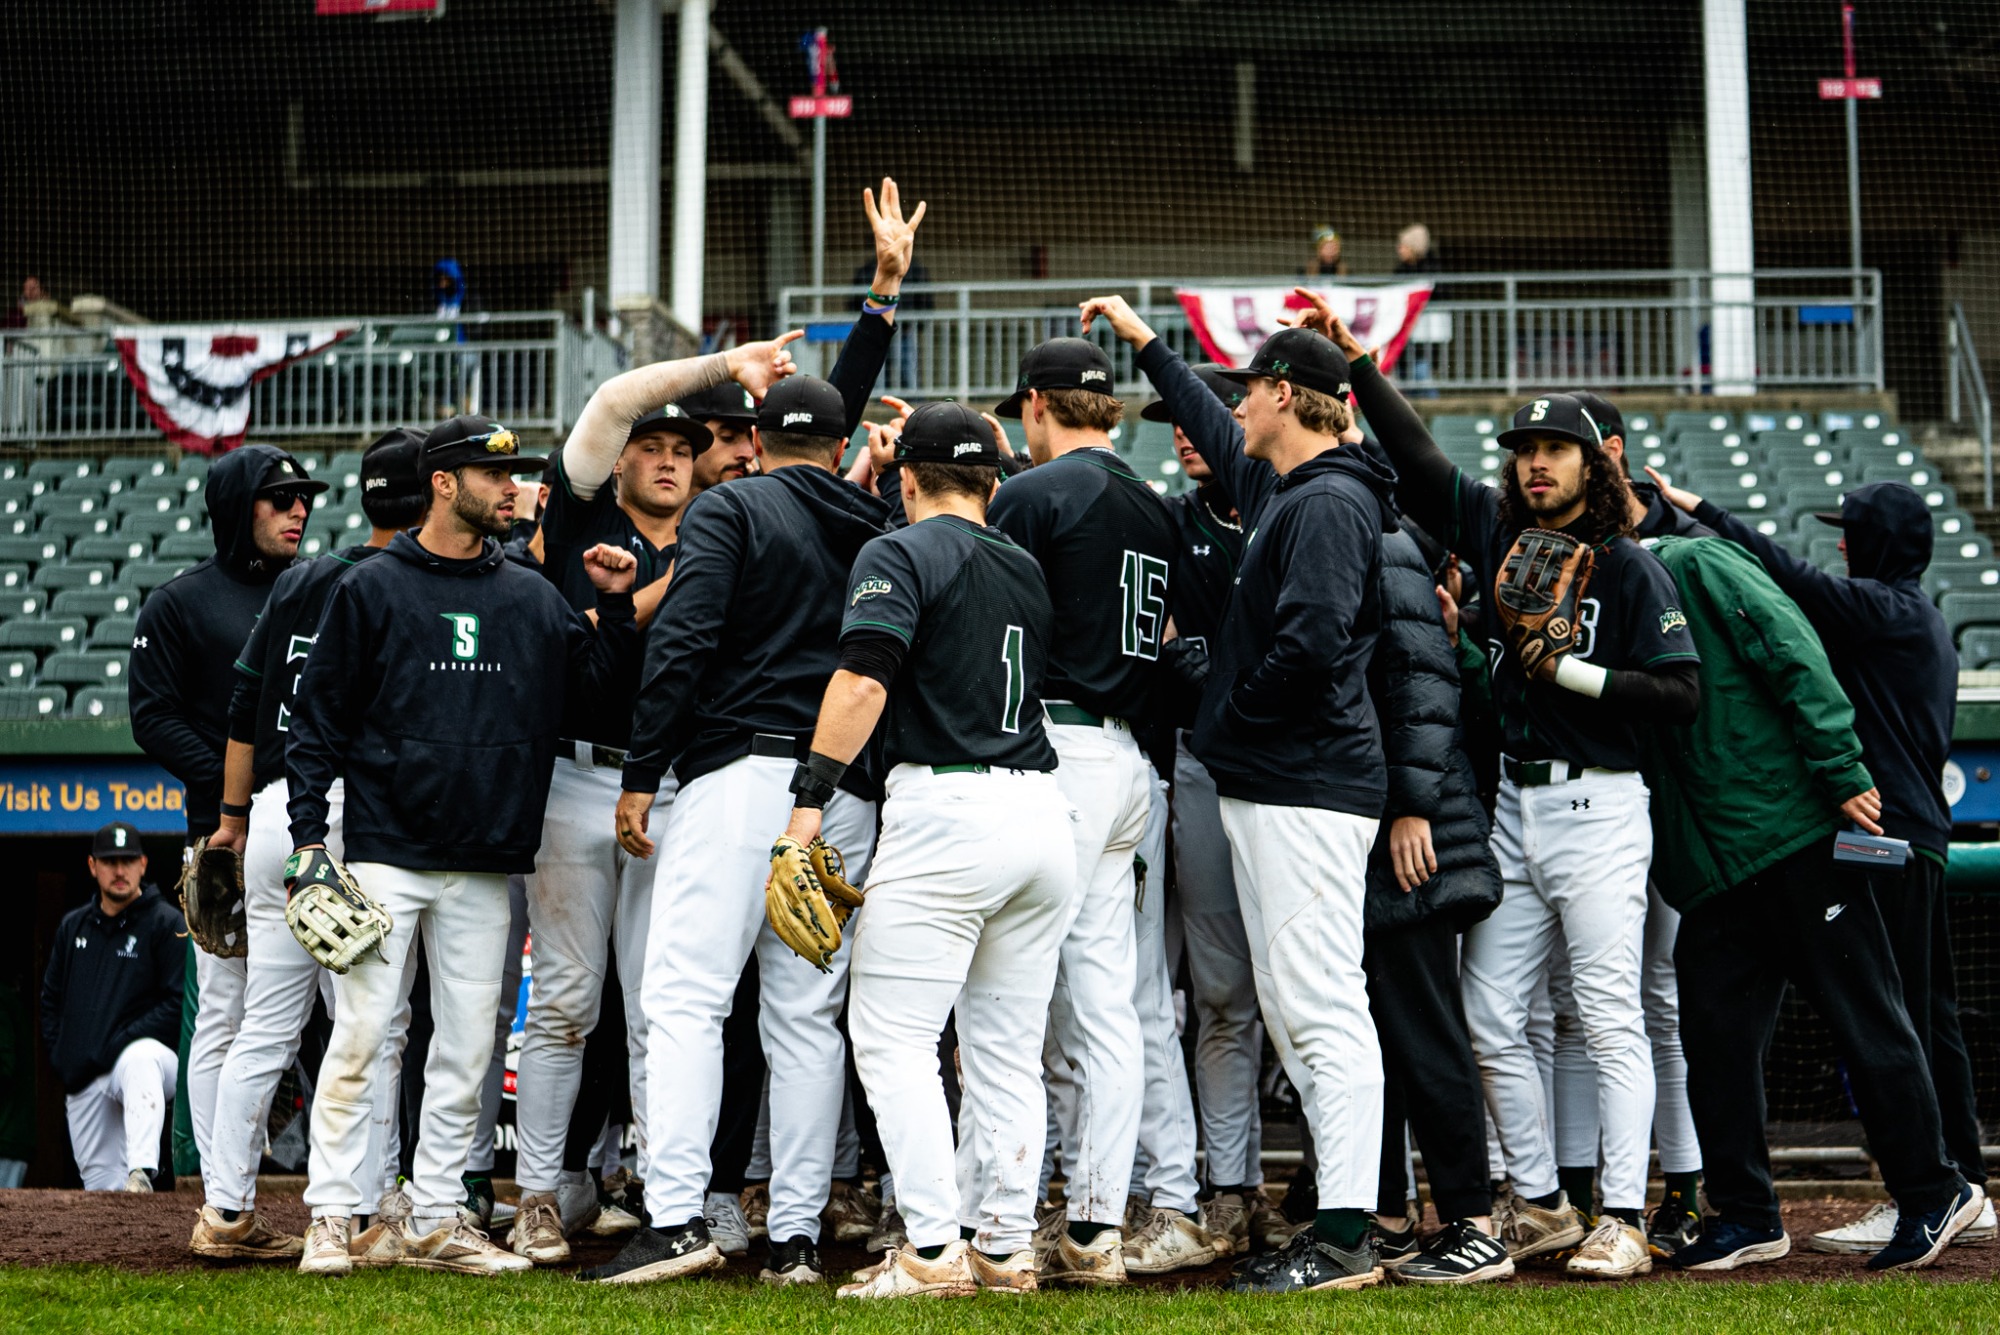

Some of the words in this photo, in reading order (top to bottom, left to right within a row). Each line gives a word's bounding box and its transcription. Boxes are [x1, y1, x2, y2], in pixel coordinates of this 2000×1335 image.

[1081, 370, 1106, 384] MAAC
[782, 412, 813, 427] MAAC
[1529, 399, 1550, 421] S
[953, 442, 982, 459] MAAC
[1120, 549, 1169, 661] 15
[448, 613, 480, 661] S
[430, 662, 501, 672] BASEBALL
[1002, 624, 1024, 735] 1
[60, 783, 100, 812] Us
[108, 782, 188, 817] Toda
